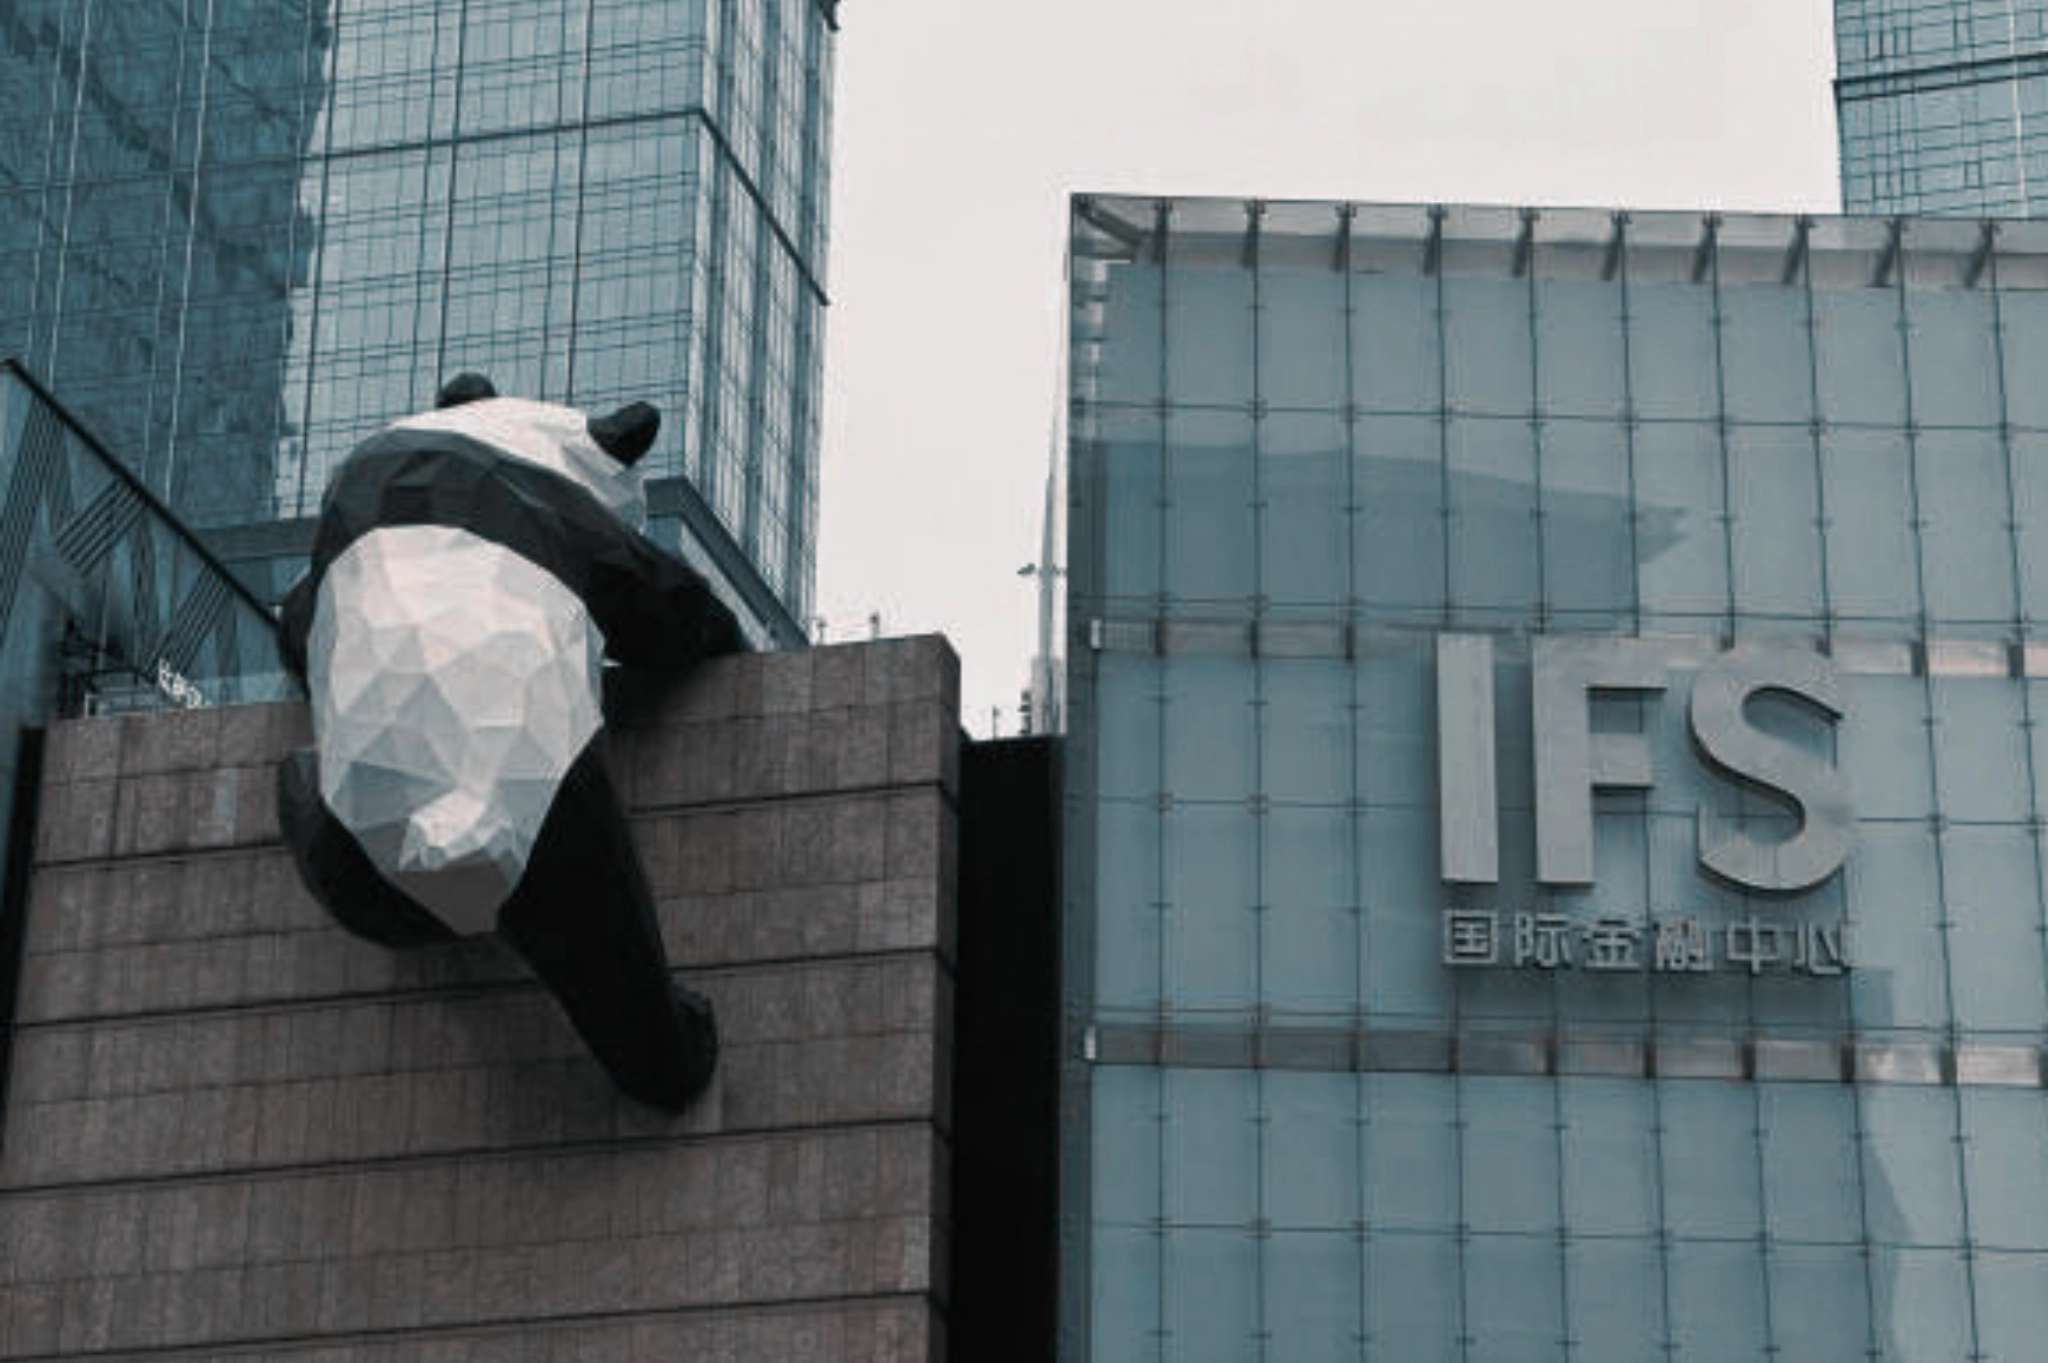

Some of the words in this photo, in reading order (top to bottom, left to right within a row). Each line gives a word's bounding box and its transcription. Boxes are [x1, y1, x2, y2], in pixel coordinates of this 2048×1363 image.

[1437, 633, 1854, 894] IFS
[1444, 909, 1855, 974] 国际金融中心
